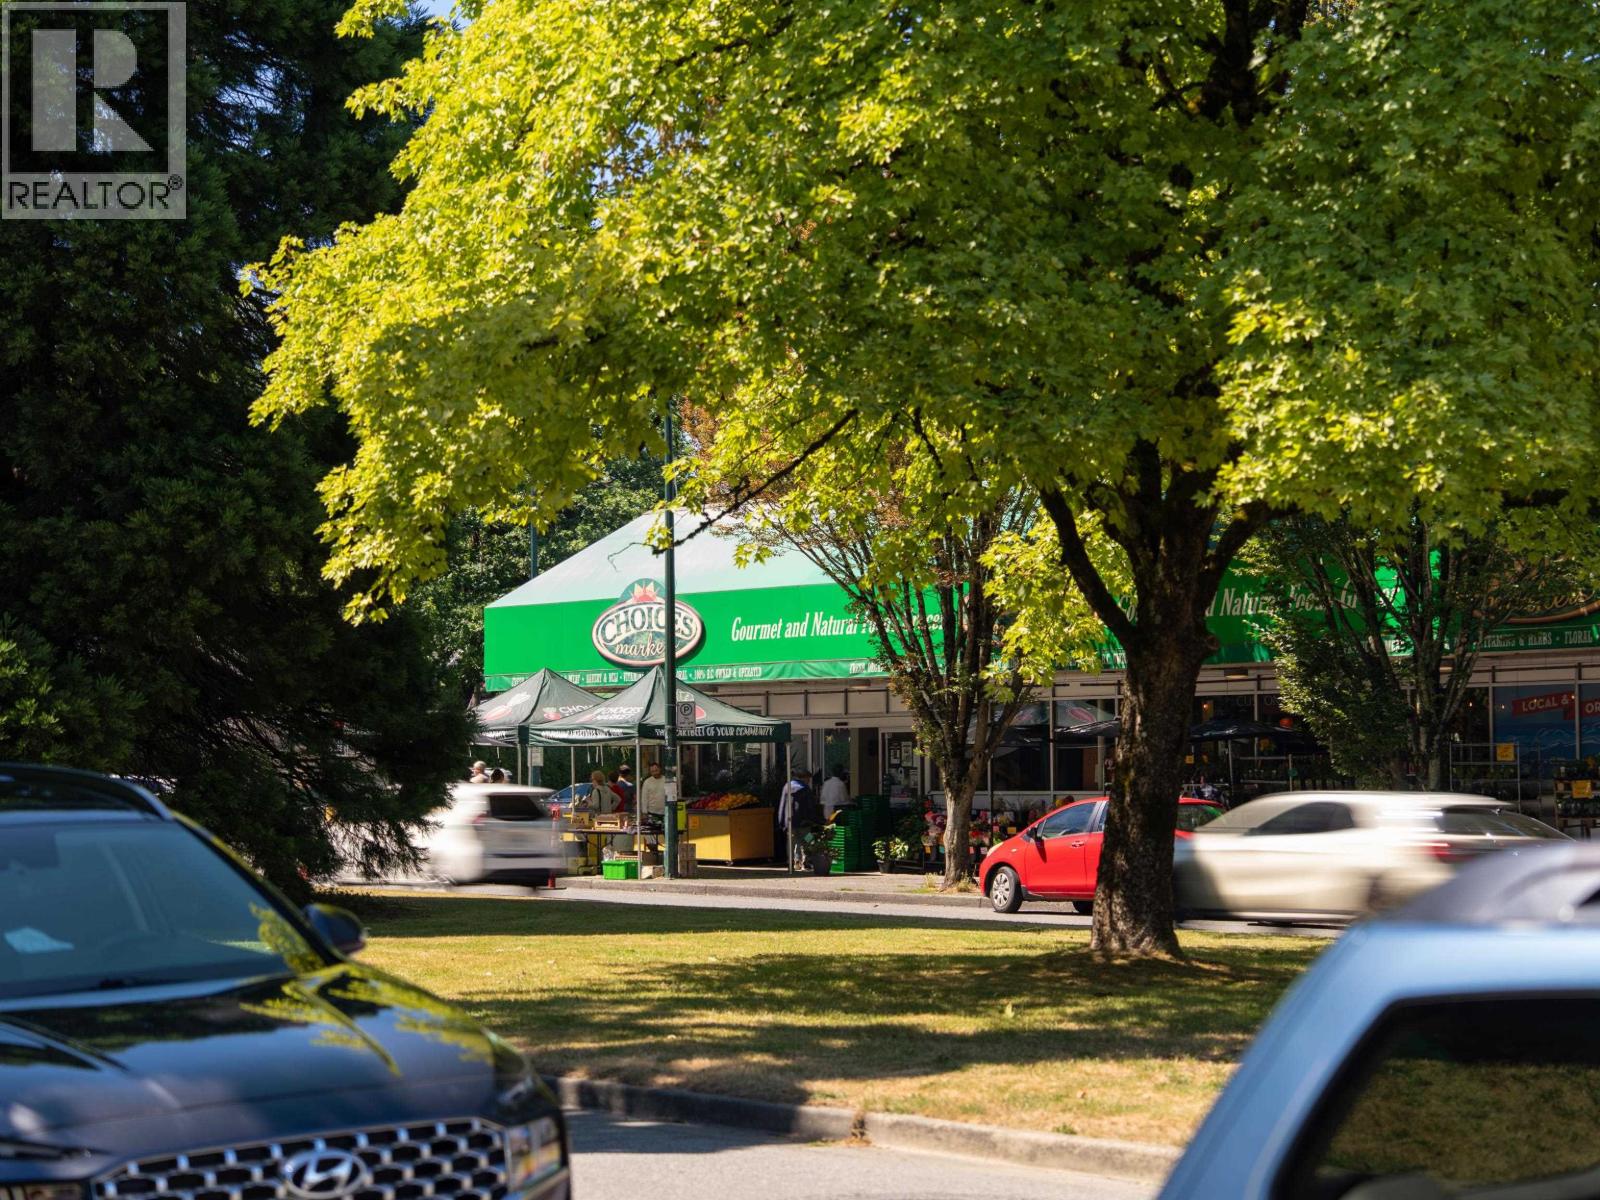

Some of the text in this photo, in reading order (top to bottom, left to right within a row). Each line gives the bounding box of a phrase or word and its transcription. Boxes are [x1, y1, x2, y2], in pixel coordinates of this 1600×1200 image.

[731, 617, 783, 641] Gourmet
[785, 609, 810, 638] and
[811, 609, 859, 636] Natural
[615, 631, 680, 656] marke
[1564, 630, 1593, 645] FLORAL
[1522, 696, 1559, 712] LOCAL
[1561, 694, 1569, 705] &
